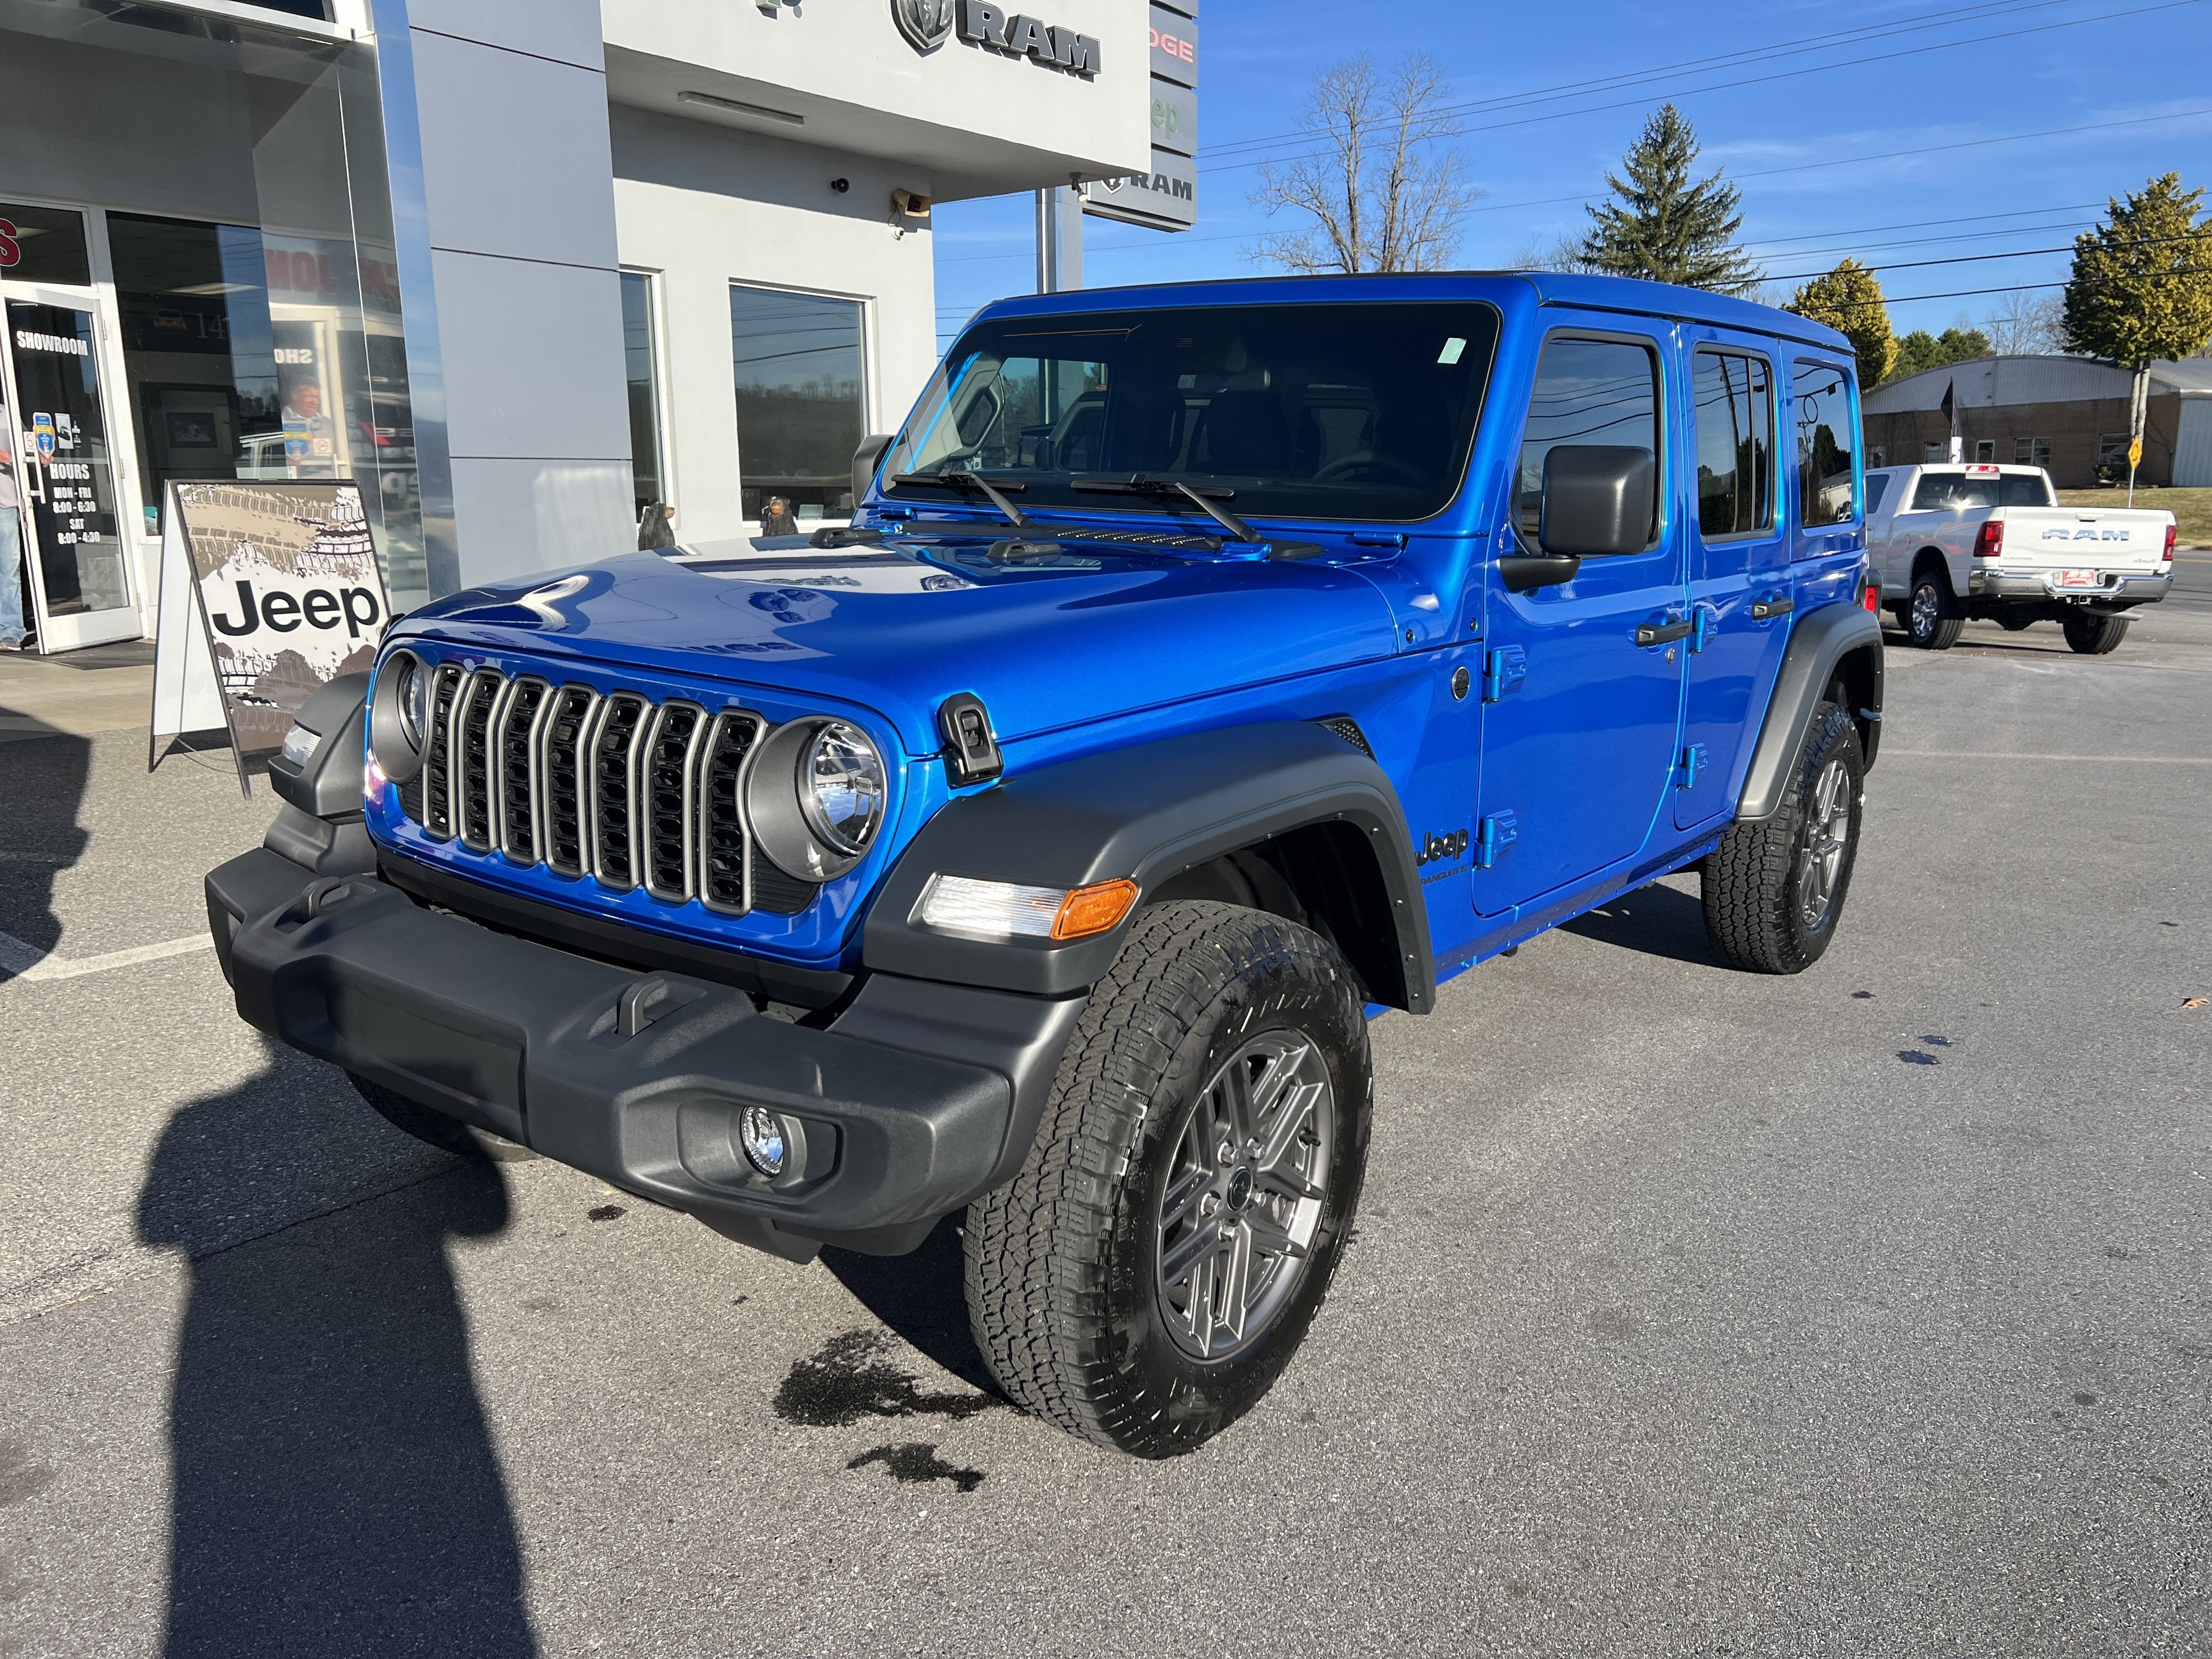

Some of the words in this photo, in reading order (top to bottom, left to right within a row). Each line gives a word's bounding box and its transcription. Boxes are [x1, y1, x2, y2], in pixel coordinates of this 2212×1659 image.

[956, 0, 1101, 75] RAM
[1131, 173, 1192, 201] RAM
[16, 330, 88, 356] SHOWROOM
[49, 463, 90, 479] HOURS
[69, 518, 84, 530] SAT
[2042, 529, 2130, 541] RAM
[211, 580, 380, 638] Jeep
[1415, 828, 1469, 866] Jeep
